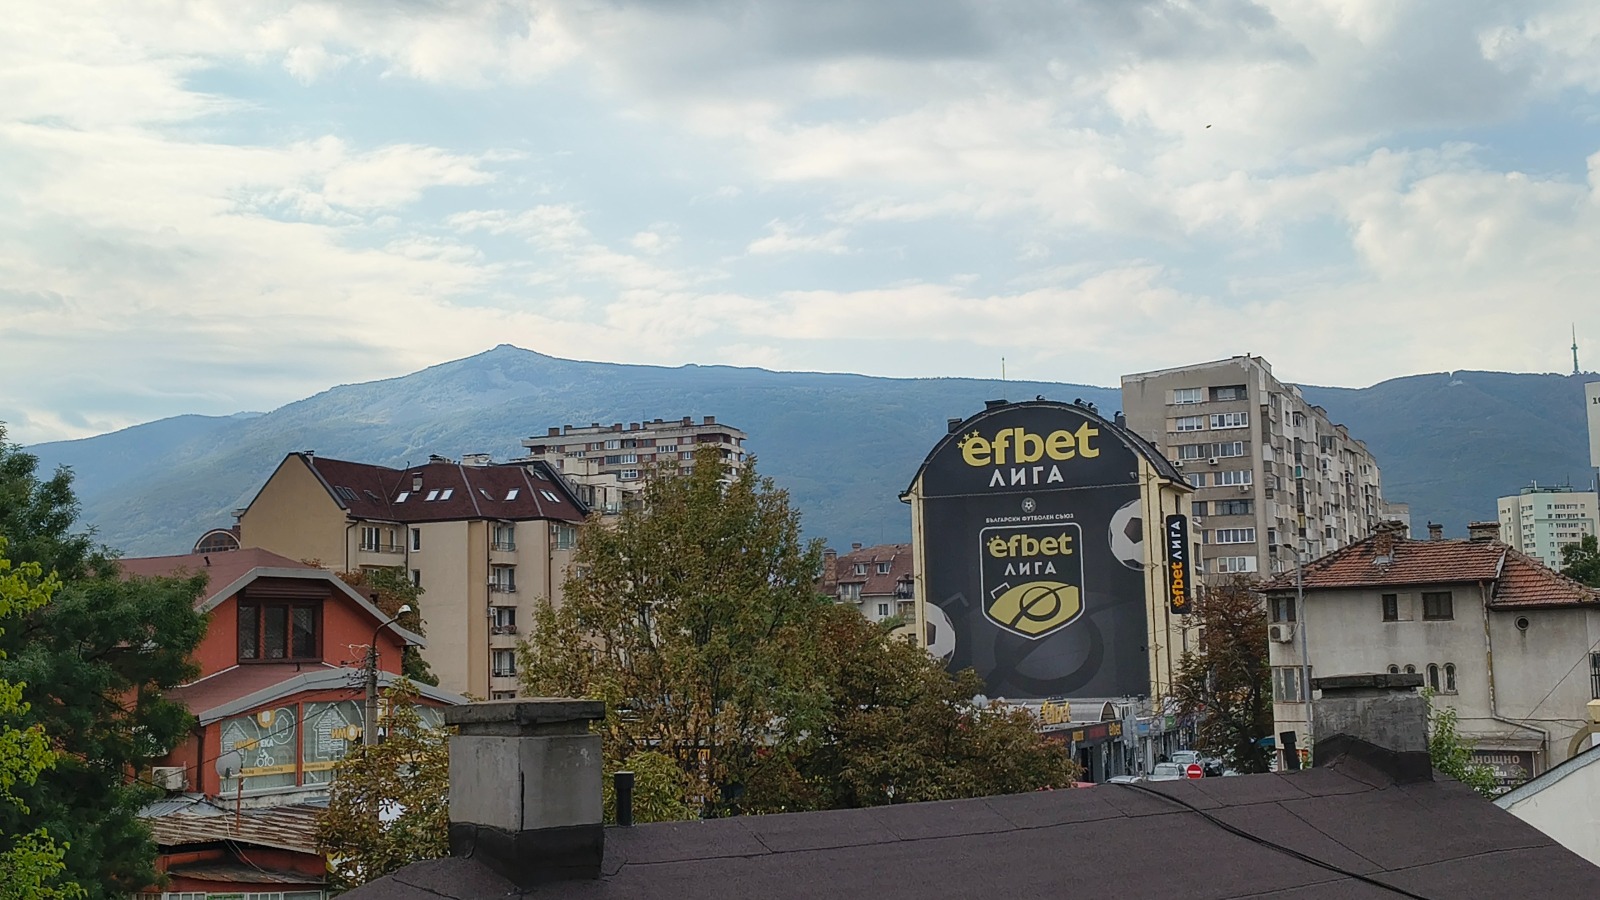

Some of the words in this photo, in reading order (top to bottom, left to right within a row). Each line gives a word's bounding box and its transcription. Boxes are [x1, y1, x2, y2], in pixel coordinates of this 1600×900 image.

[961, 421, 1099, 467] efbet
[988, 464, 1064, 488] ЛИГА
[985, 516, 1021, 524] БЪЛГАРСКИ
[1021, 514, 1054, 522] ФУТБОЛЕН
[1055, 512, 1074, 520] СЪЮЗ
[988, 532, 1073, 558] efbet
[1170, 520, 1182, 560] ЛИГА
[1004, 561, 1057, 576] ЛИГА
[1171, 561, 1185, 607] efbet
